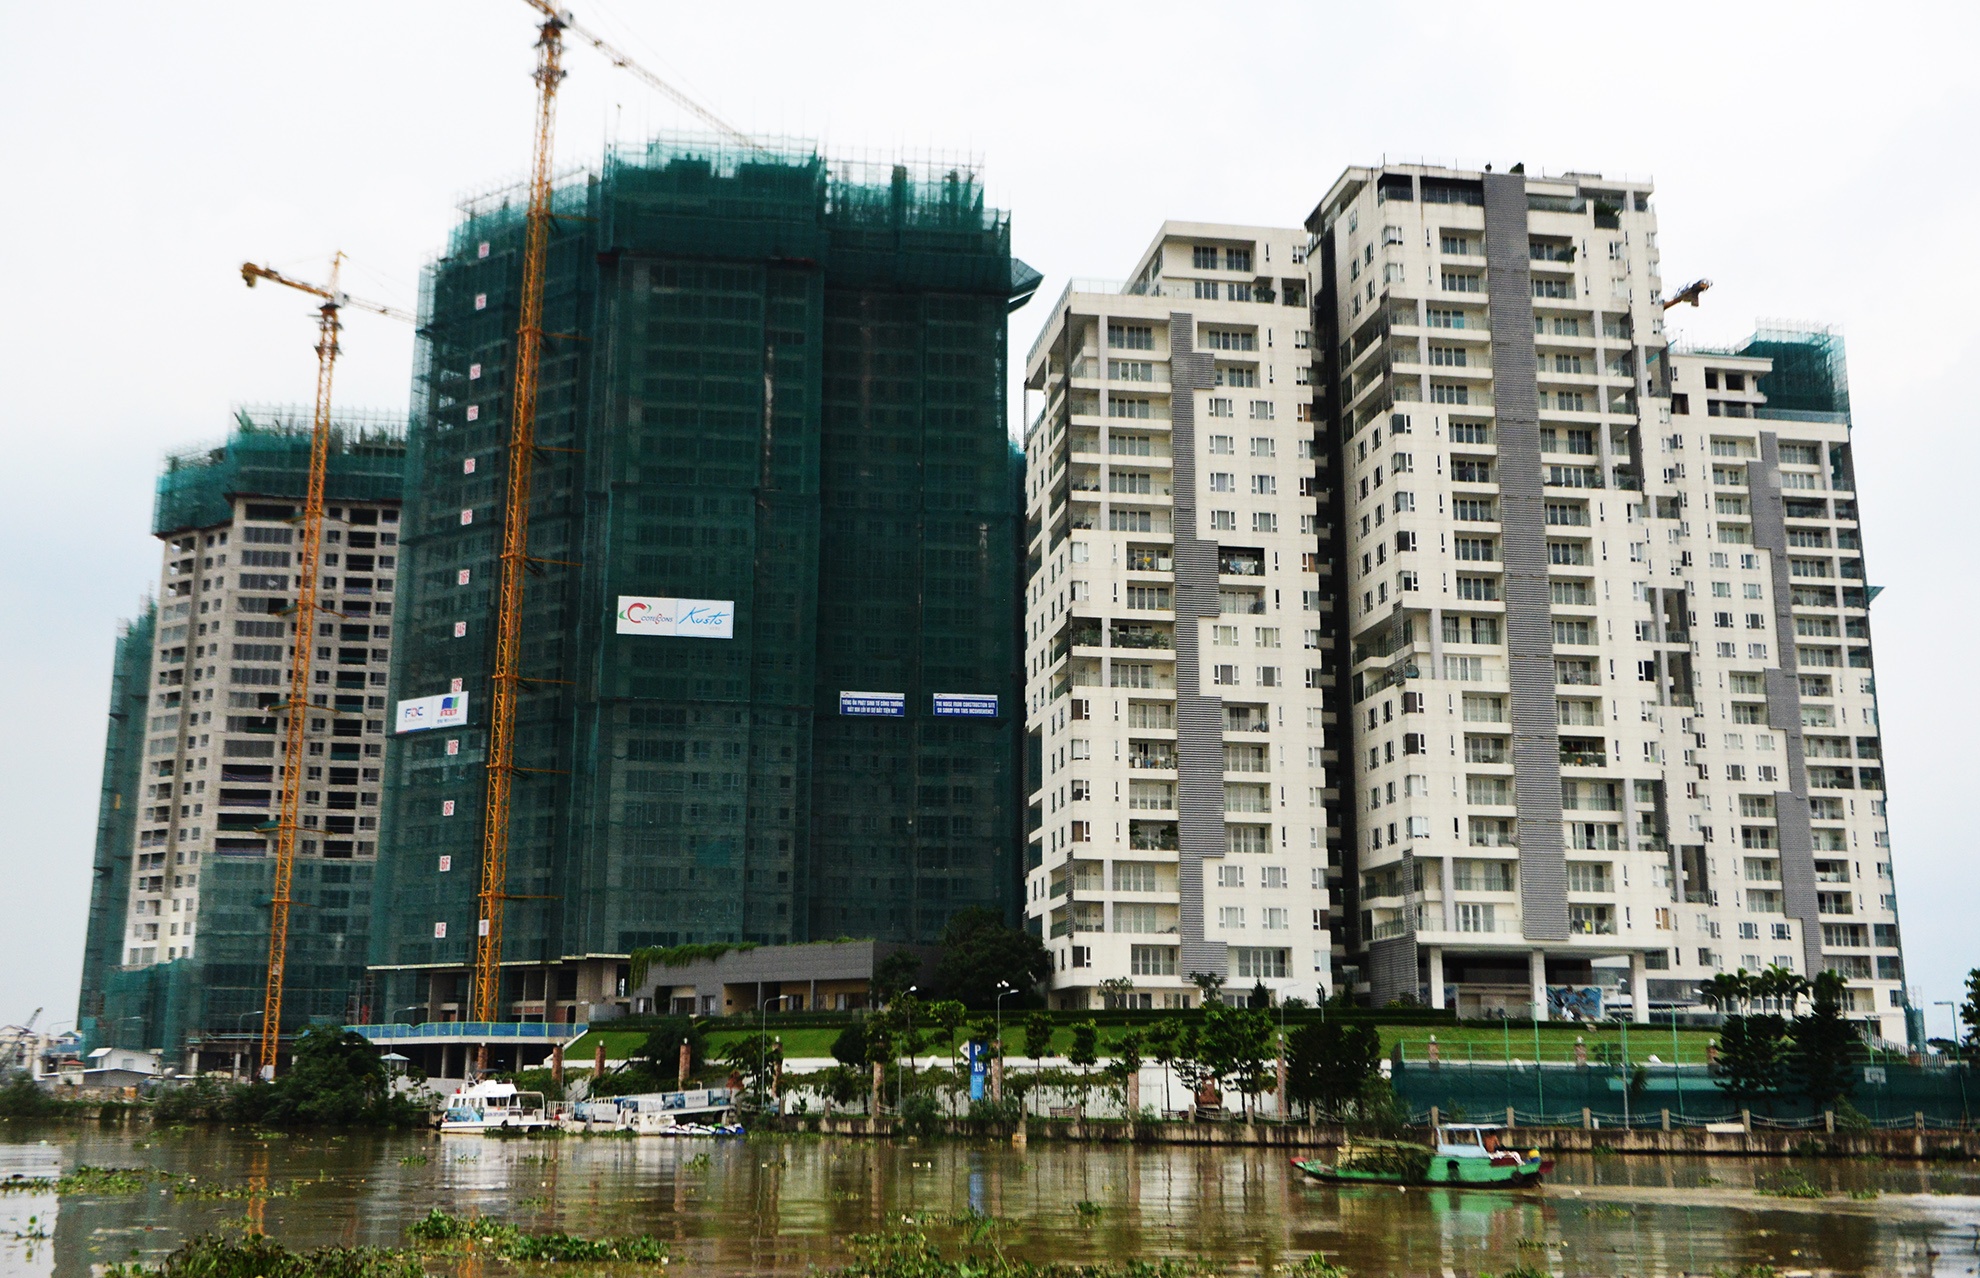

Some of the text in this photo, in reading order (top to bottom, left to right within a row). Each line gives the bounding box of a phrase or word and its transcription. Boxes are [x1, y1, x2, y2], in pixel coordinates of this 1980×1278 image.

[679, 607, 730, 625] Kusto
[445, 802, 454, 814] 8F
[442, 857, 449, 870] 6F
[437, 924, 445, 936] 4F
[975, 1044, 981, 1056] P
